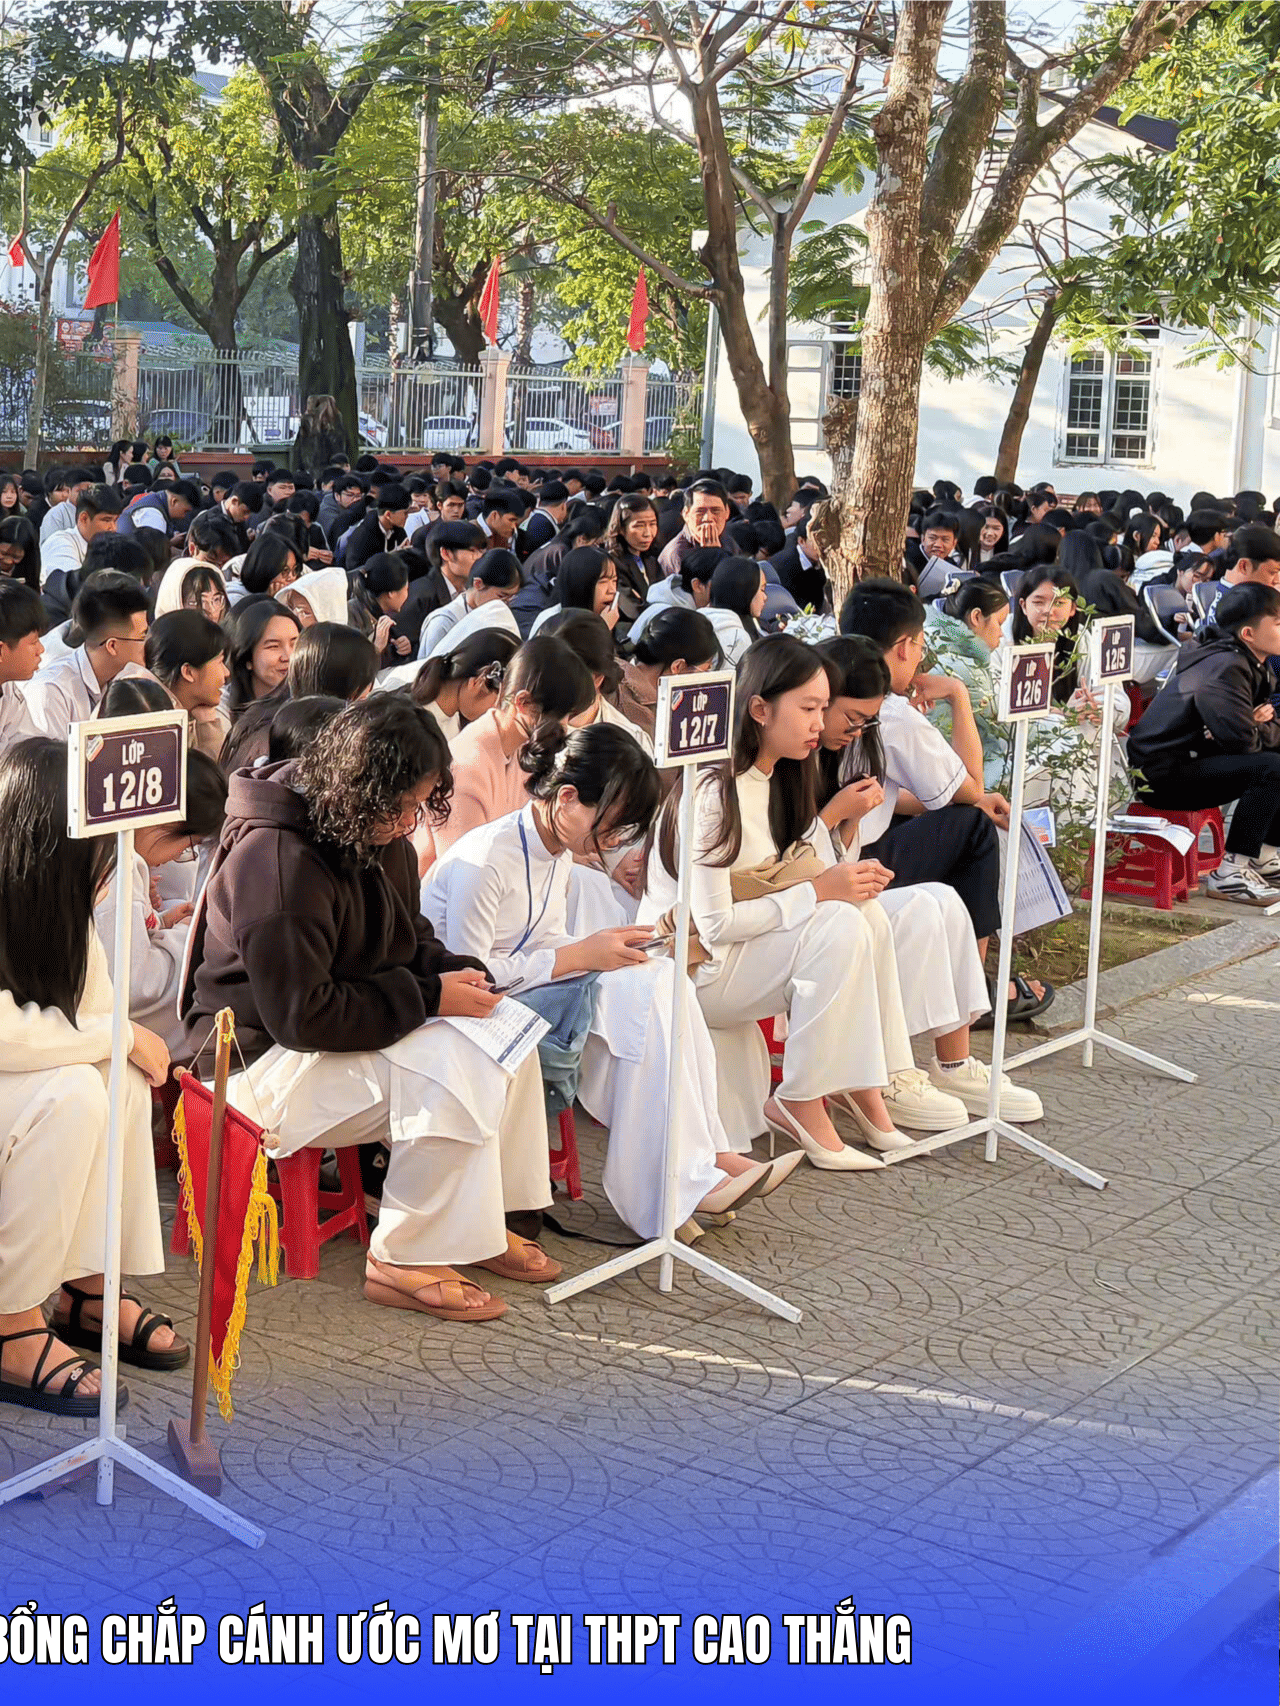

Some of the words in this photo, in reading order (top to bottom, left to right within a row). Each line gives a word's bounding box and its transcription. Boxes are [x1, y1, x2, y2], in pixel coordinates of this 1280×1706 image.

[1105, 647, 1126, 672] 12/5
[692, 691, 708, 712] LỚP
[1015, 679, 1042, 707] 12/6
[679, 713, 718, 748] 12/7
[122, 739, 145, 766] LỚP
[103, 766, 163, 813] 12/8
